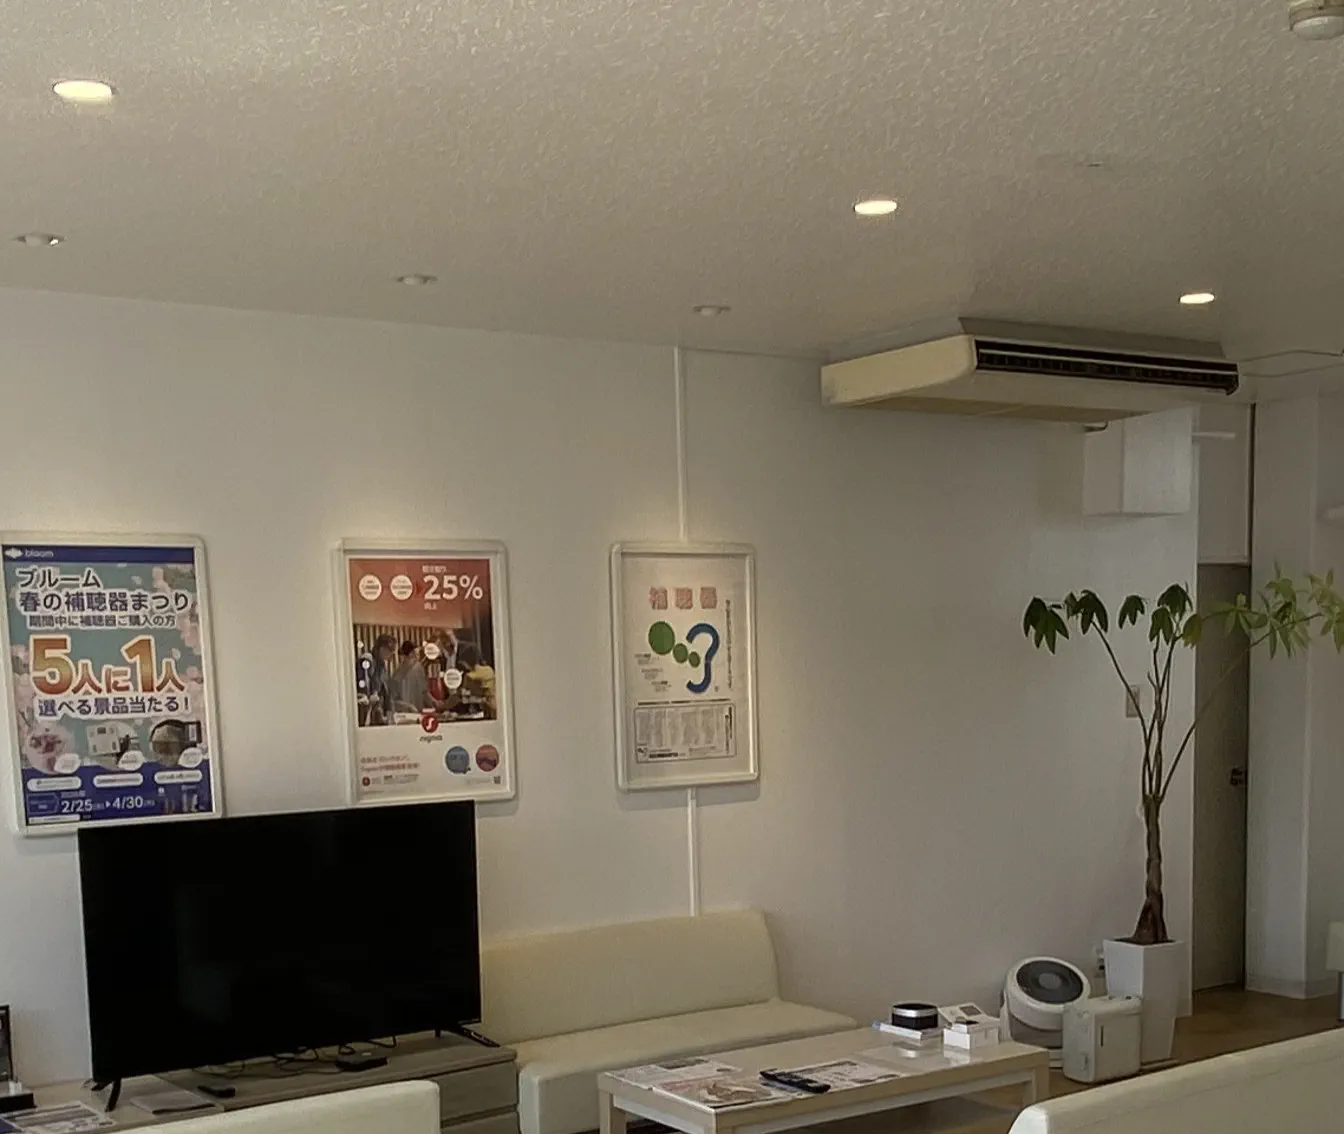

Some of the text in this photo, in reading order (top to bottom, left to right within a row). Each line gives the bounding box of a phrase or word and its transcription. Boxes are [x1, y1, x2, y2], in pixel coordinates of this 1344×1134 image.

[18, 568, 101, 588] ブルーム
[423, 574, 483, 600] 25%
[19, 592, 189, 612] 春の補聴器まつり
[29, 615, 176, 628] 期間中に補聴器ご購入の方
[31, 636, 186, 695] 5人に1人
[61, 798, 93, 813] 2/25
[112, 796, 144, 810] 4/30
